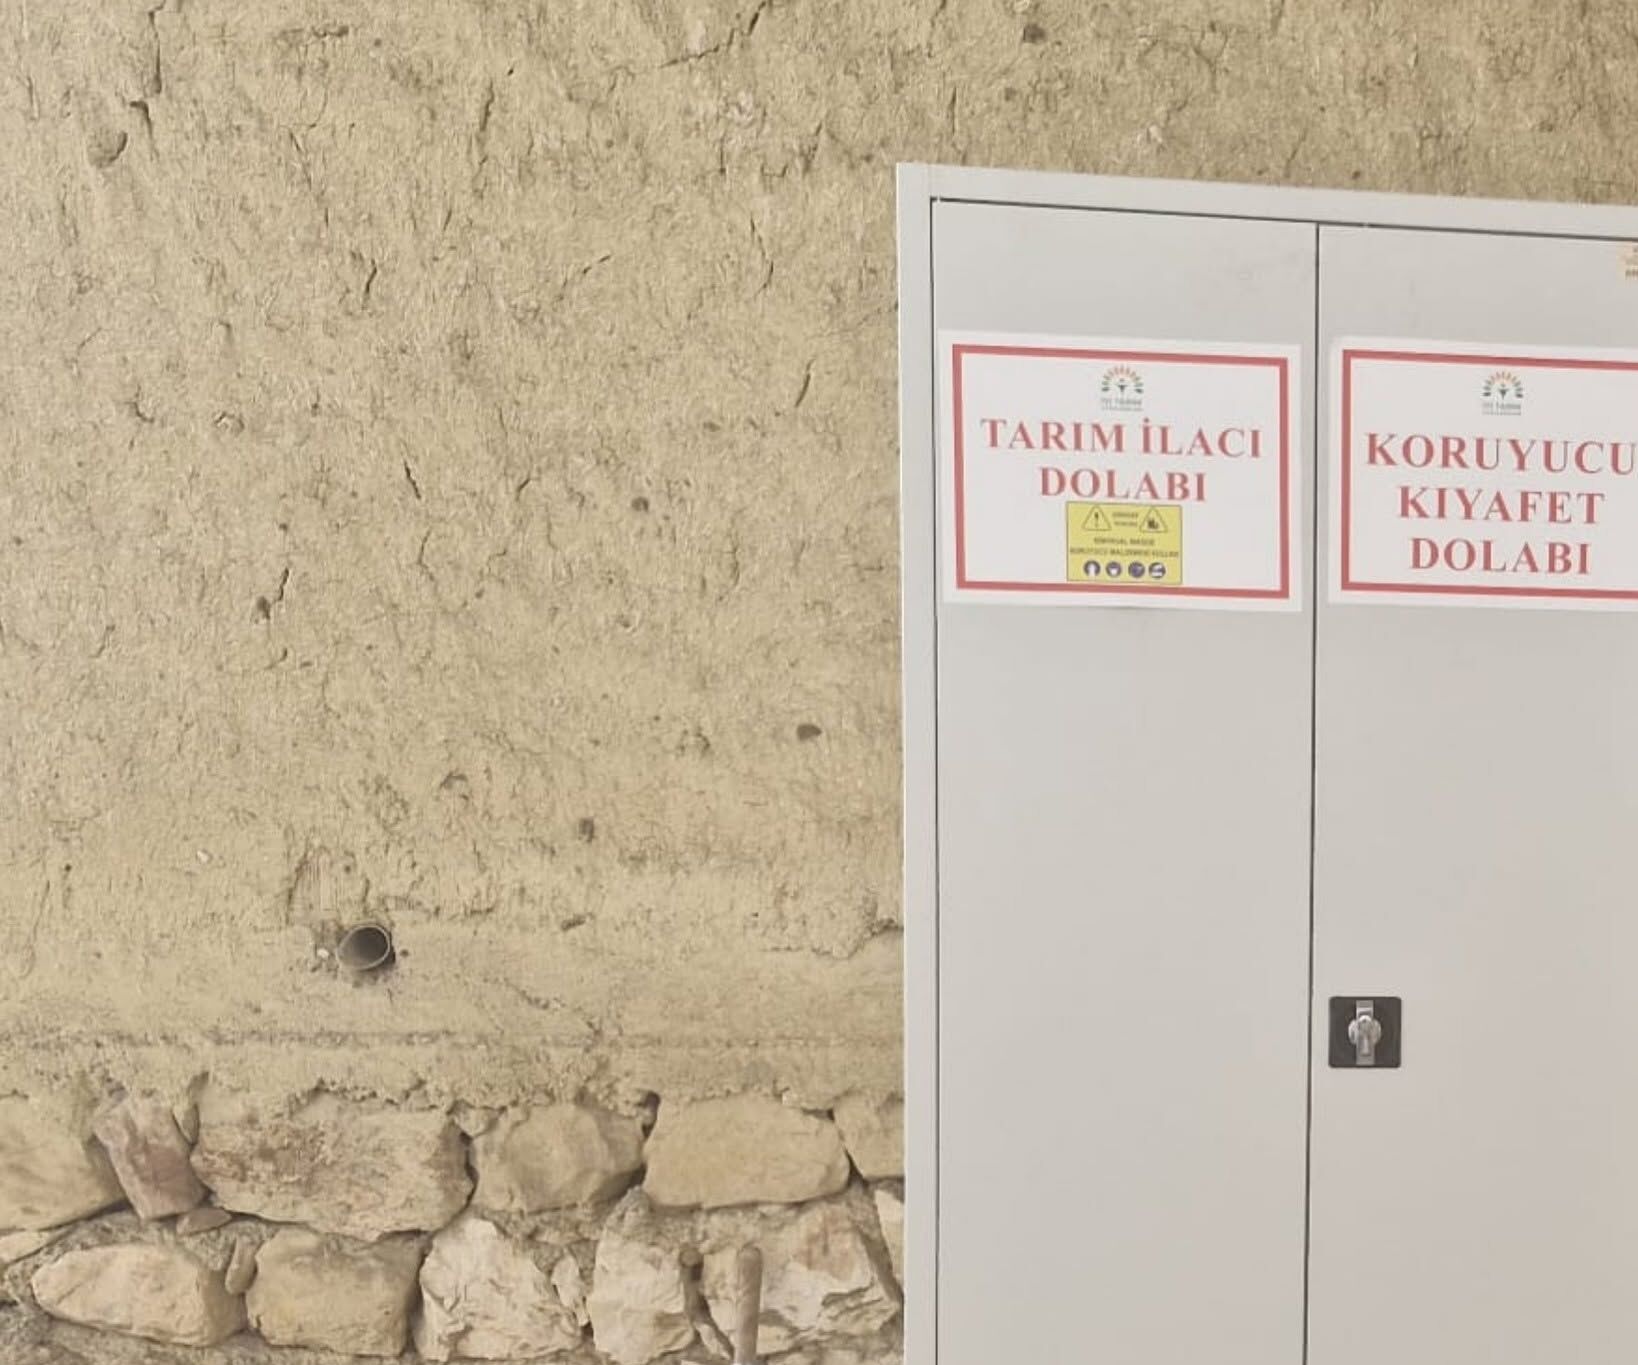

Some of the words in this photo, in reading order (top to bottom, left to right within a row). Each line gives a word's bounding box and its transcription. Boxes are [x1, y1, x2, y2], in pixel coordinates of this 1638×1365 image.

[982, 418, 1126, 453] TARIM
[1141, 416, 1262, 459] İLACI
[1366, 433, 1637, 475] KORUYUCU
[1039, 466, 1207, 501] DOLABI
[1398, 485, 1606, 525] KIYAFET
[1410, 537, 1591, 576] DOLABI
